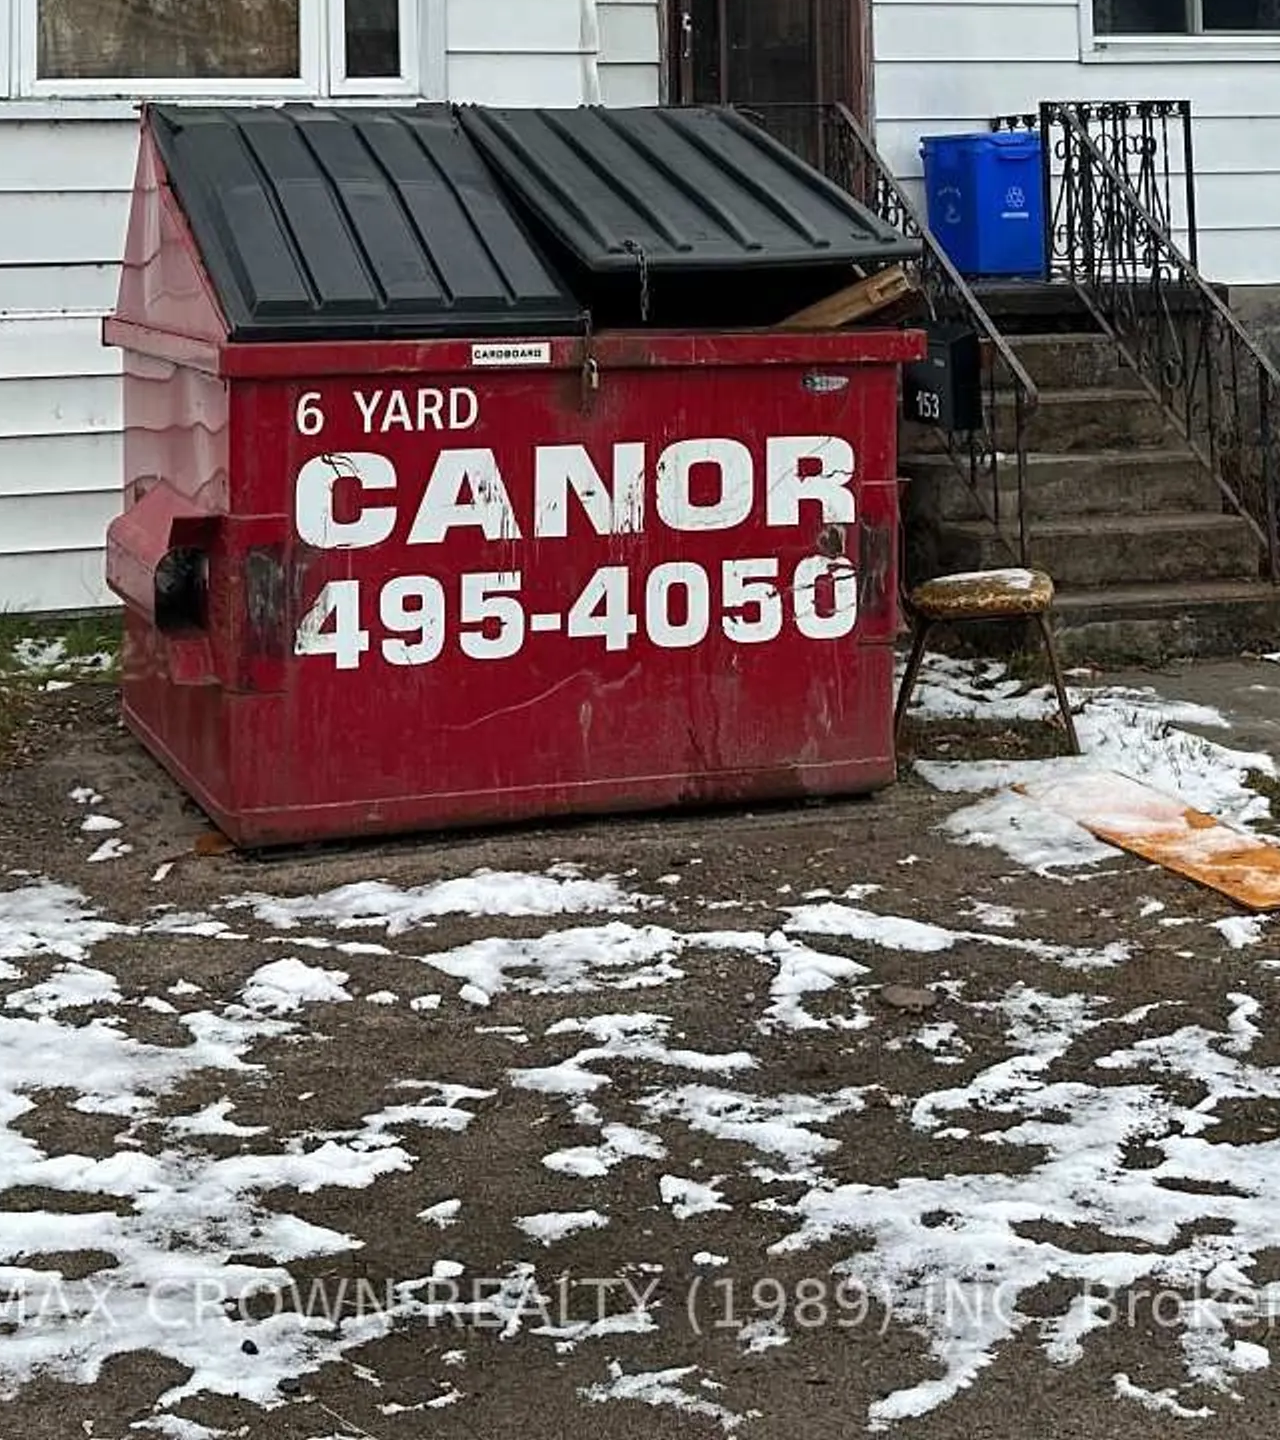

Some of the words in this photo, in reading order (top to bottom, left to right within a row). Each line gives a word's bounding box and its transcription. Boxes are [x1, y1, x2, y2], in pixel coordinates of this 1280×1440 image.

[296, 392, 324, 436] 6
[352, 387, 479, 433] YARD
[915, 390, 940, 418] 153
[295, 435, 857, 550] CANOR
[293, 553, 859, 671] 495-4050
